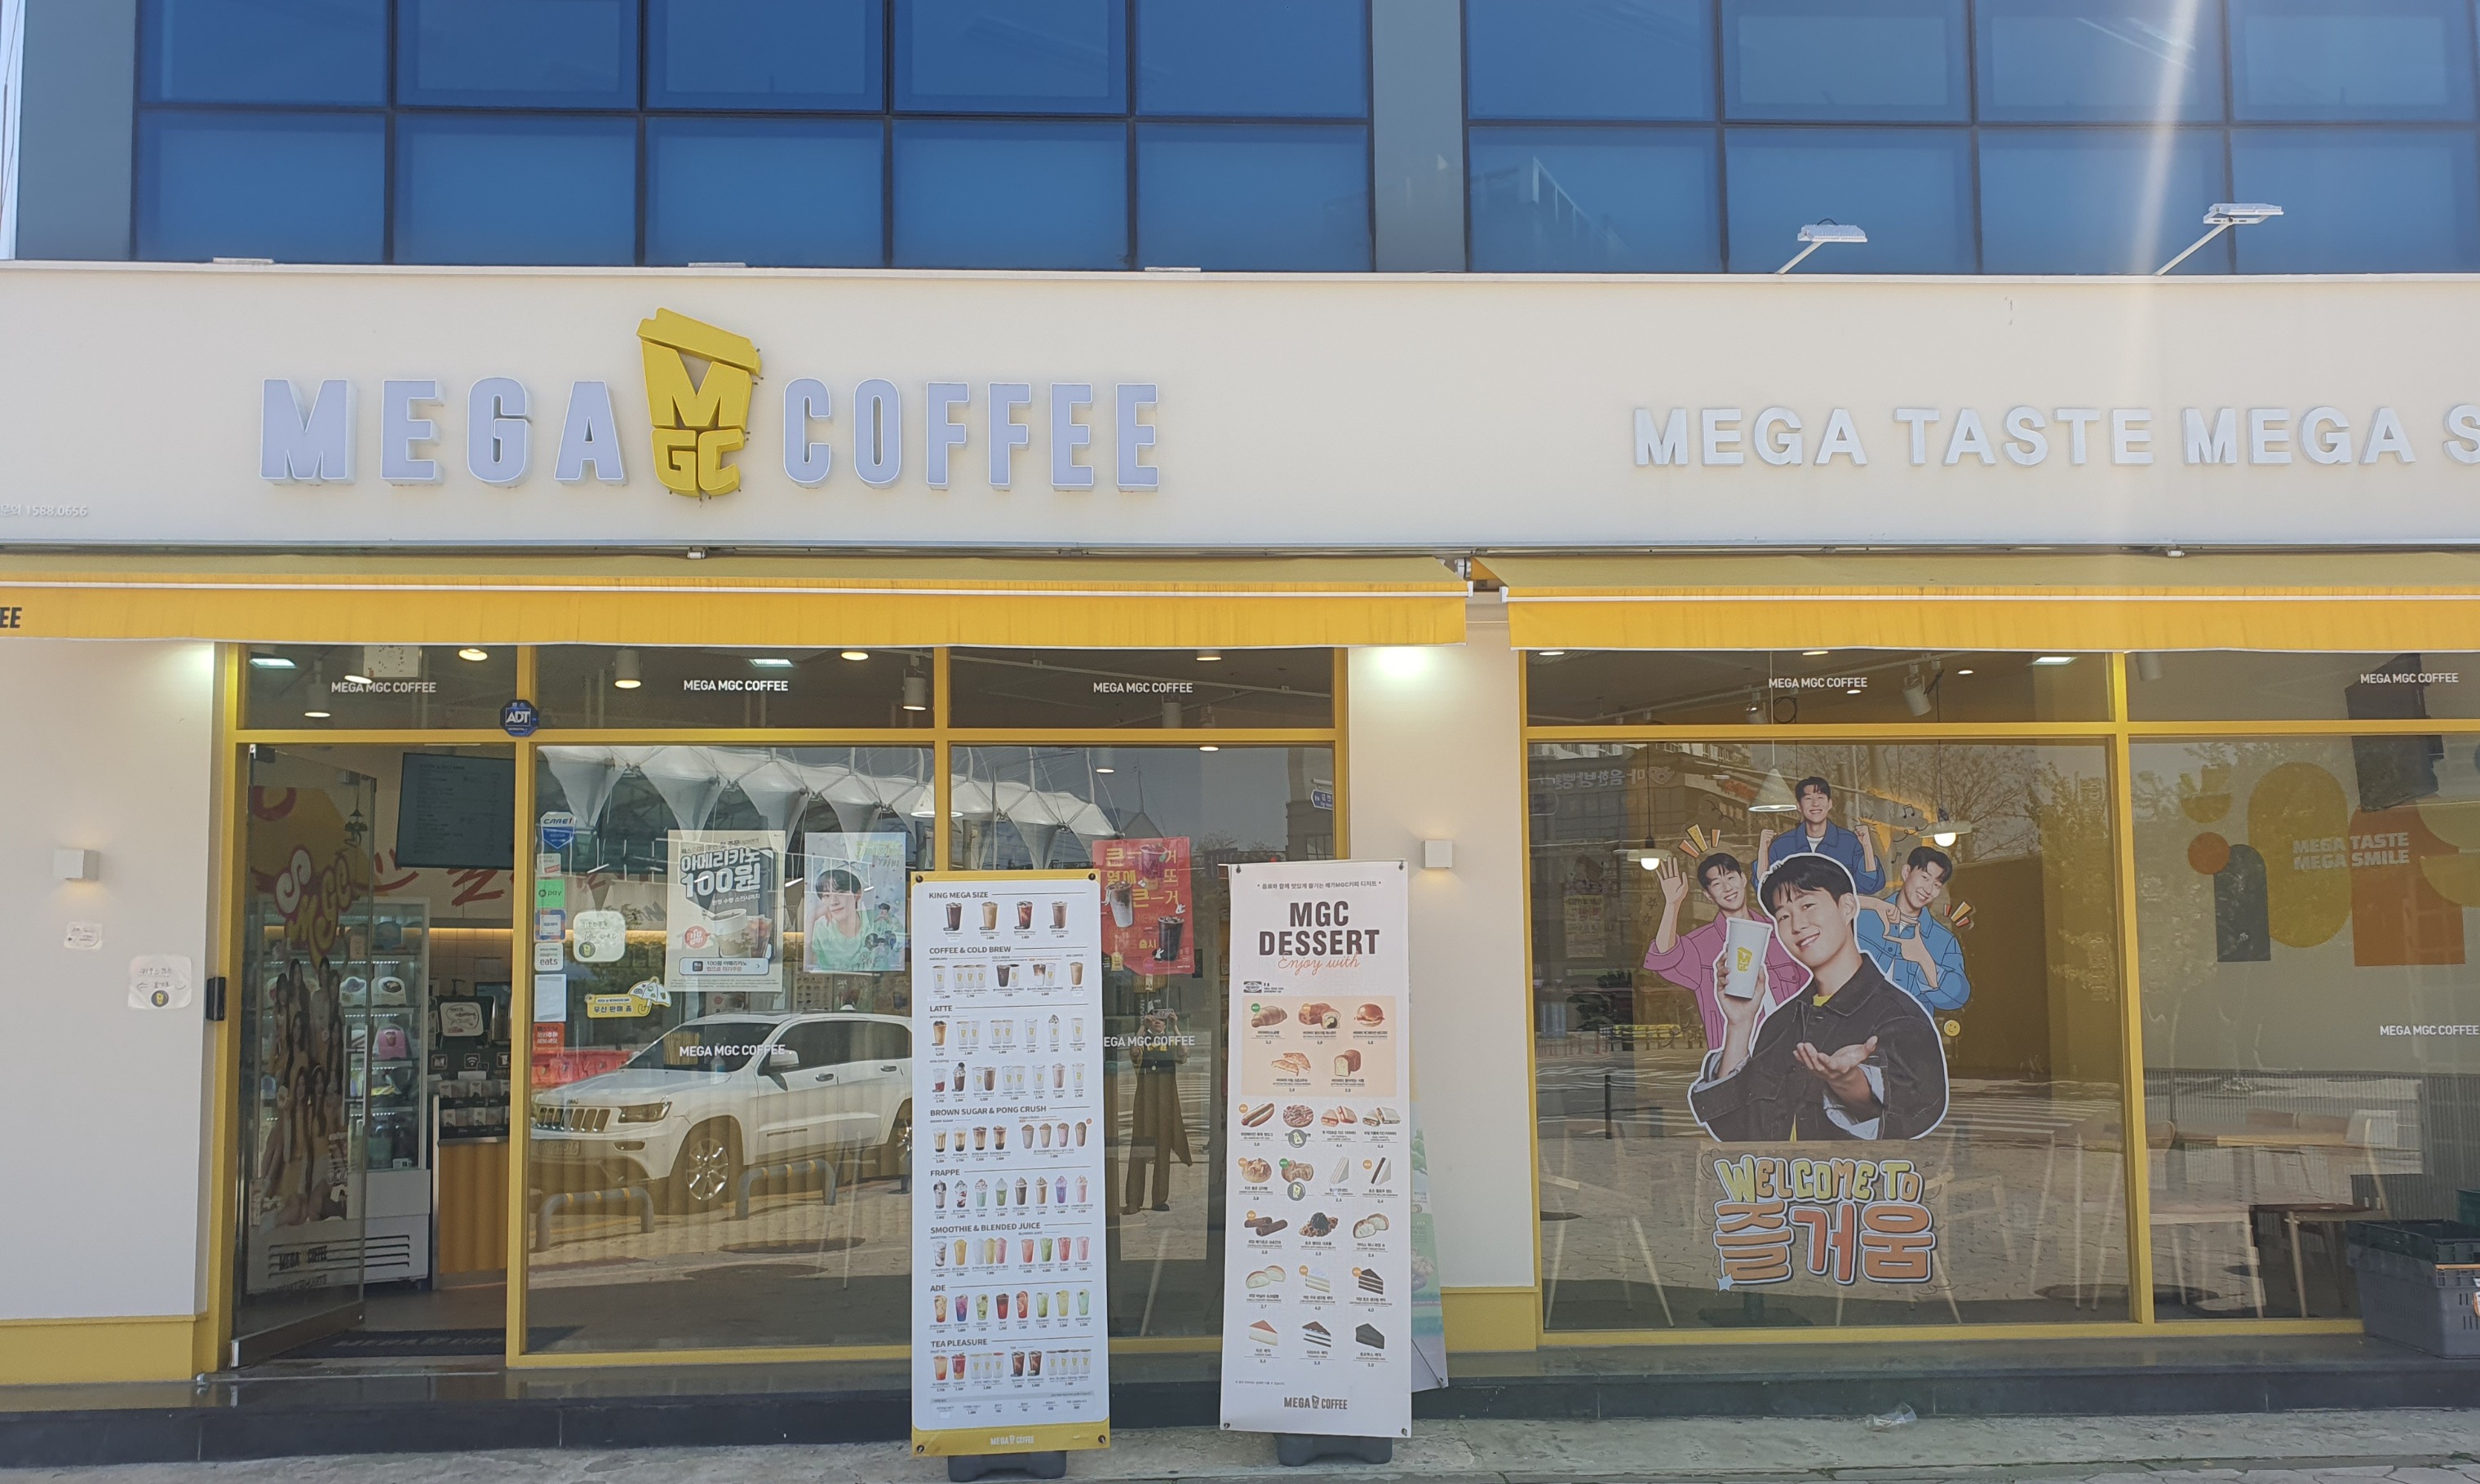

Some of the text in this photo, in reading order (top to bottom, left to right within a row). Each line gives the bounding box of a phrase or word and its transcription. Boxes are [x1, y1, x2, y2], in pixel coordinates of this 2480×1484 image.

[260, 376, 1160, 491] MEGA COFFEE
[1634, 406, 1868, 466] MEGA
[1894, 405, 2154, 466] TASTE
[2183, 406, 2417, 465] MEGA
[27, 504, 89, 517] 1588.0656
[1769, 677, 1868, 689] MEGA MGC COFFEE
[2360, 672, 2460, 684] MEGA MGC COFFEE
[331, 682, 437, 693] MEGA MGC COFFEE
[684, 680, 789, 691] MEGA MGC COFFEE
[1093, 682, 1194, 693] MEGA MGC COFFEE
[506, 711, 531, 724] ADT
[2292, 831, 2410, 854] MEGA TASTE
[680, 847, 761, 872] 아메리카노
[2293, 849, 2411, 870] MEGA SMILE
[680, 862, 761, 898] 100원
[1290, 901, 1349, 928] MGC
[1259, 929, 1380, 956] DESSERT
[539, 957, 559, 966] eats
[1278, 950, 1360, 976] Enjoy with
[2380, 1025, 2480, 1036] MEGA MGC COFFEE
[1104, 1034, 1196, 1048] EGA MGC COFFEE
[680, 1043, 786, 1057] MEGA MGC COFFEE
[1716, 1155, 1878, 1203] WELCOME
[930, 1225, 972, 1234] SMOOTHIE
[981, 1224, 1017, 1232] BLENDED
[1714, 1198, 1935, 1283] 즐거움
[1283, 1397, 1348, 1410] MEGA COFFEE
